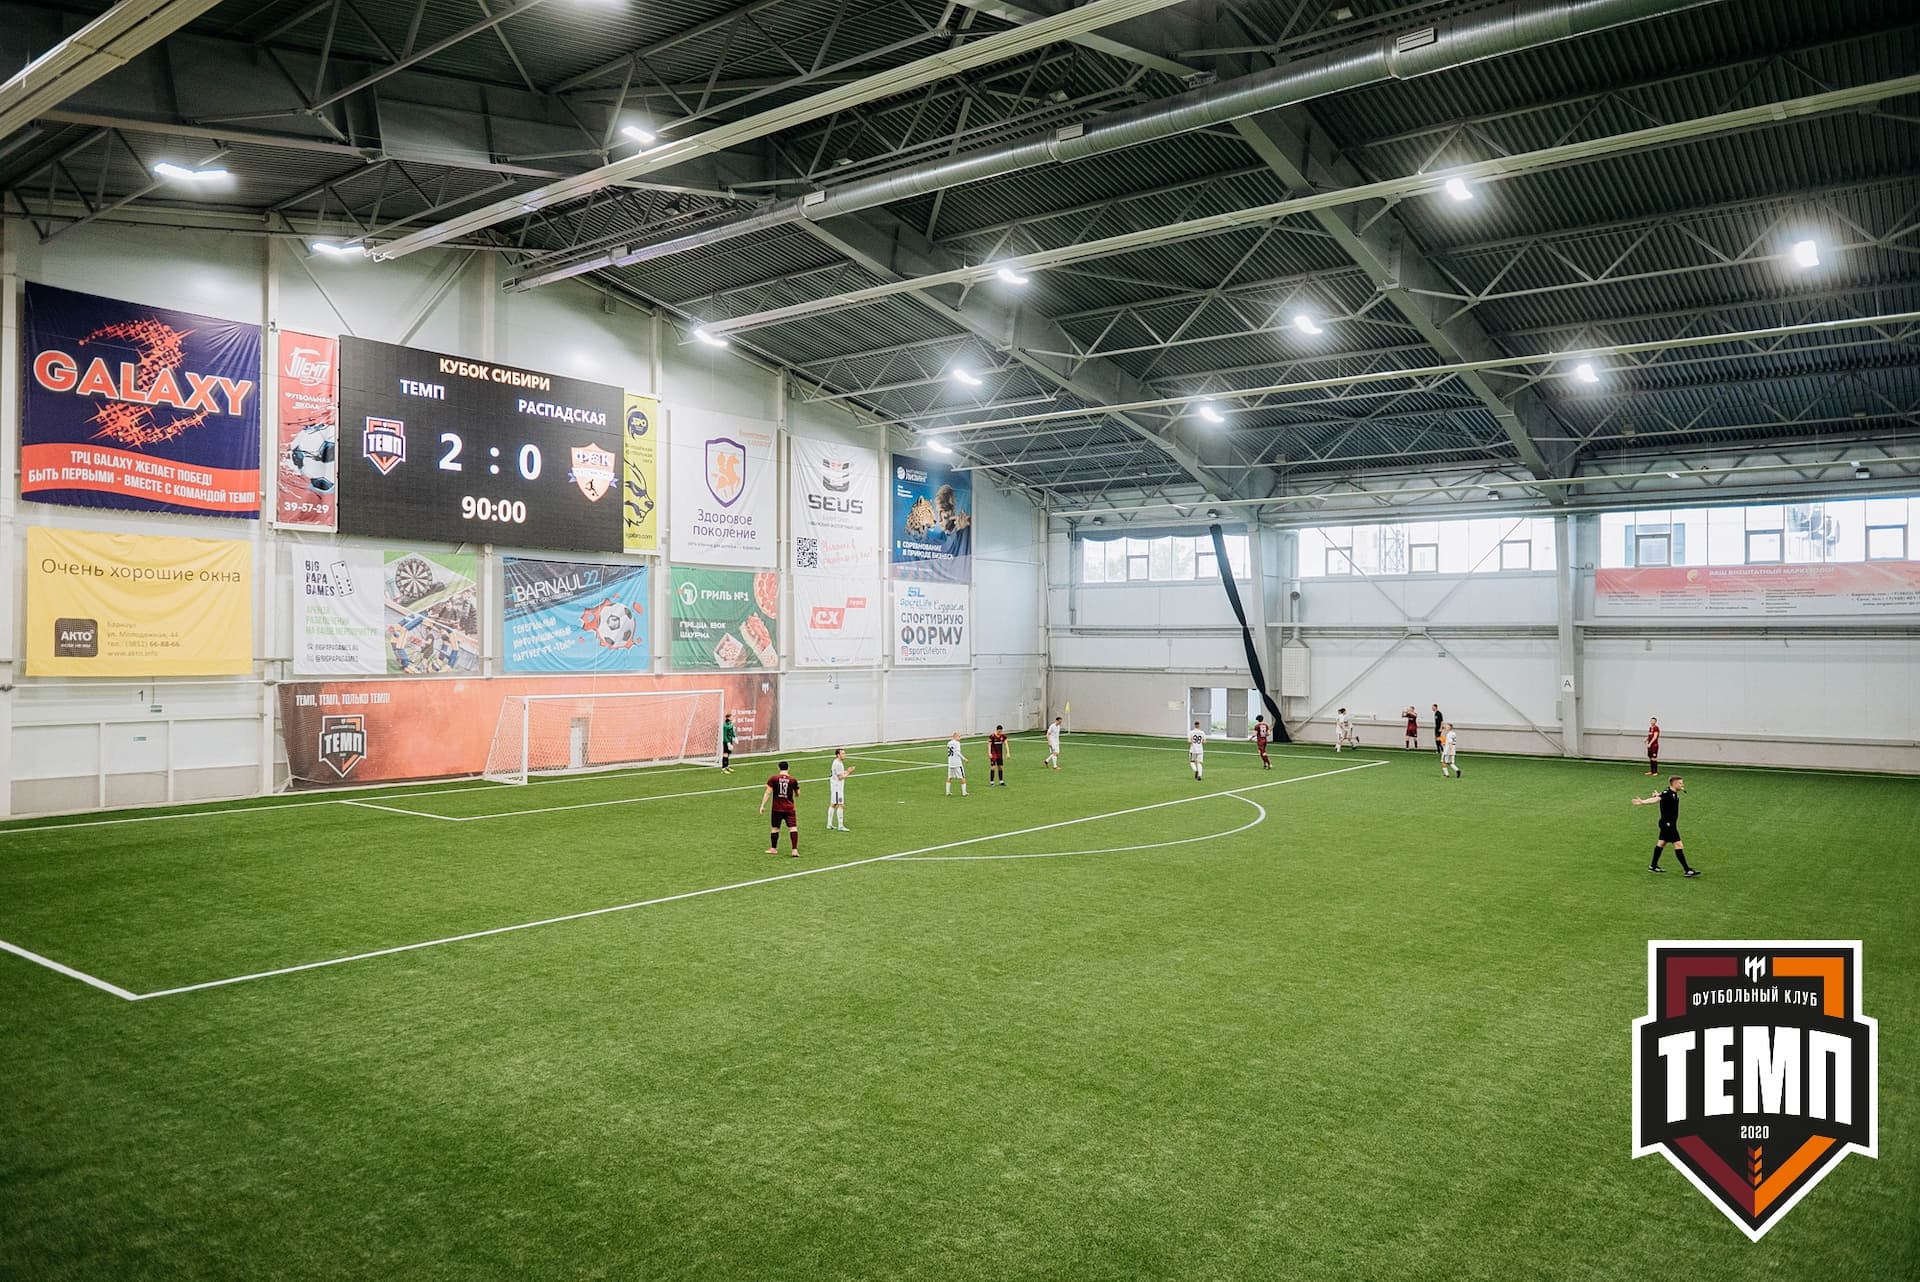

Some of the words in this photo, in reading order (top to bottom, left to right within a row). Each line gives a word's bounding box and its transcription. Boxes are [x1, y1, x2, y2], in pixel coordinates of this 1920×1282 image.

[33, 350, 252, 416] GALAXY
[439, 358, 489, 381] КУБОК
[491, 367, 550, 392] СИБИРИ
[400, 379, 445, 400] ТЕМП
[518, 399, 606, 427] РАСПАДСКАЯ
[438, 433, 462, 473] 2
[518, 443, 542, 480] 0
[70, 450, 91, 466] ТРЦ
[94, 452, 133, 469] GALAXY
[135, 460, 174, 479] ЖЕЛАЕТ
[177, 470, 212, 486] ПОБЕД!
[28, 468, 59, 483] БЫТЬ
[62, 467, 114, 484] ПЕРВЫМИ
[124, 476, 163, 493] ВМЕСТЕ
[165, 482, 172, 494] С
[174, 483, 226, 503] КОМАНДОЙ
[228, 492, 255, 503] ТЕМП!
[284, 502, 329, 514] 39-57-29
[461, 495, 527, 524] 90:00
[808, 494, 863, 514] SEUS
[697, 508, 752, 525] Здоровое
[693, 525, 756, 540] поколение
[41, 558, 104, 576] Очень
[110, 566, 194, 582] хорошие
[199, 571, 241, 582] окна
[305, 560, 320, 571] BIG
[306, 573, 328, 584] PAPA
[514, 574, 586, 602] BARNAUL
[583, 570, 599, 586] 22
[306, 584, 335, 596] GAMES
[701, 590, 732, 600] ГРИЛЬ
[900, 612, 964, 625] СПОРТИВНУЮ
[60, 630, 92, 641] АКТО
[901, 625, 963, 645] ФОРМУ
[1564, 679, 1571, 688] A
[137, 689, 144, 701] 1
[296, 694, 318, 706] ТЕМП,
[319, 694, 340, 706] ТЕМП,
[342, 693, 368, 705] ТОЛЬКО
[370, 693, 391, 705] ТЕМП!
[324, 732, 362, 754] ТЕМП
